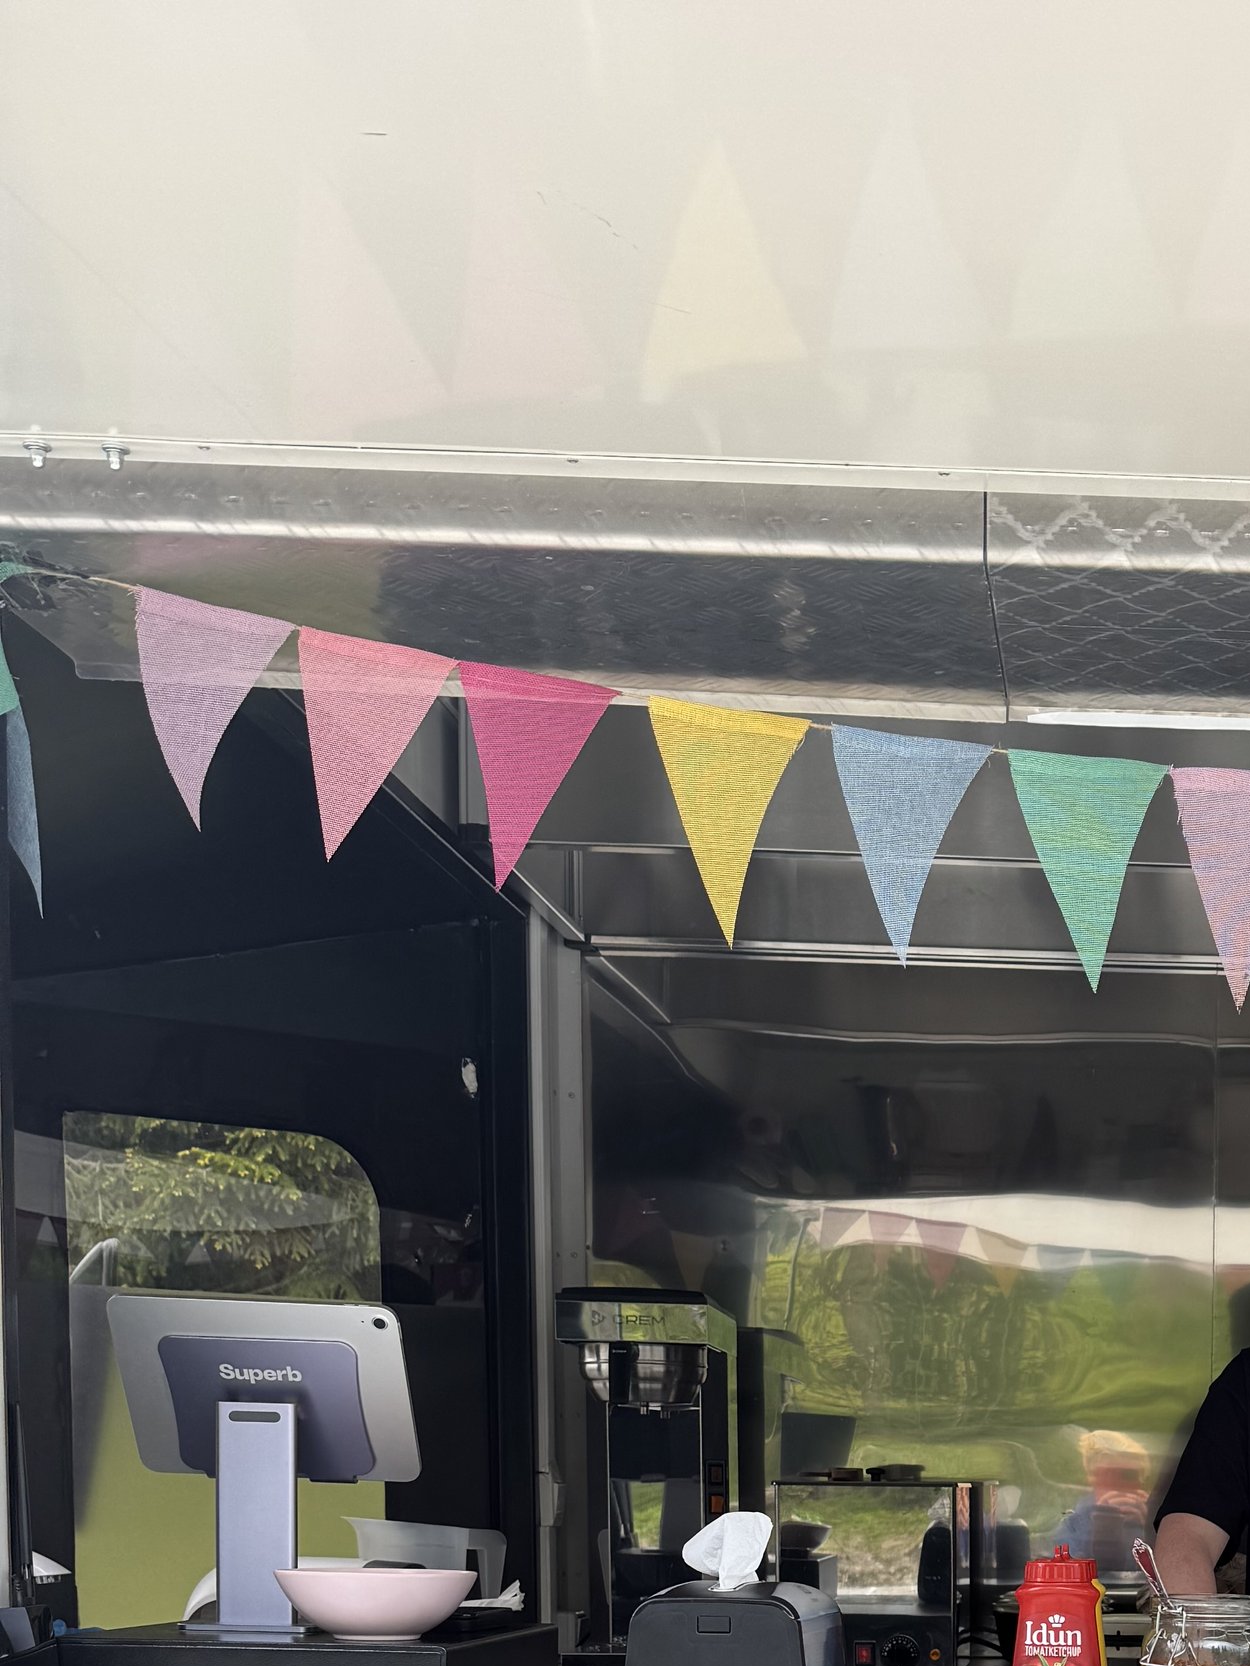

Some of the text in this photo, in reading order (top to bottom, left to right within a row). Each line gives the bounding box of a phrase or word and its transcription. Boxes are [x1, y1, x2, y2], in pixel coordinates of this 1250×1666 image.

[613, 1315, 666, 1327] CREM
[219, 1363, 302, 1384] Superb
[1025, 1620, 1082, 1646] Idun
[1025, 1646, 1082, 1657] TOMATKETCHUP
